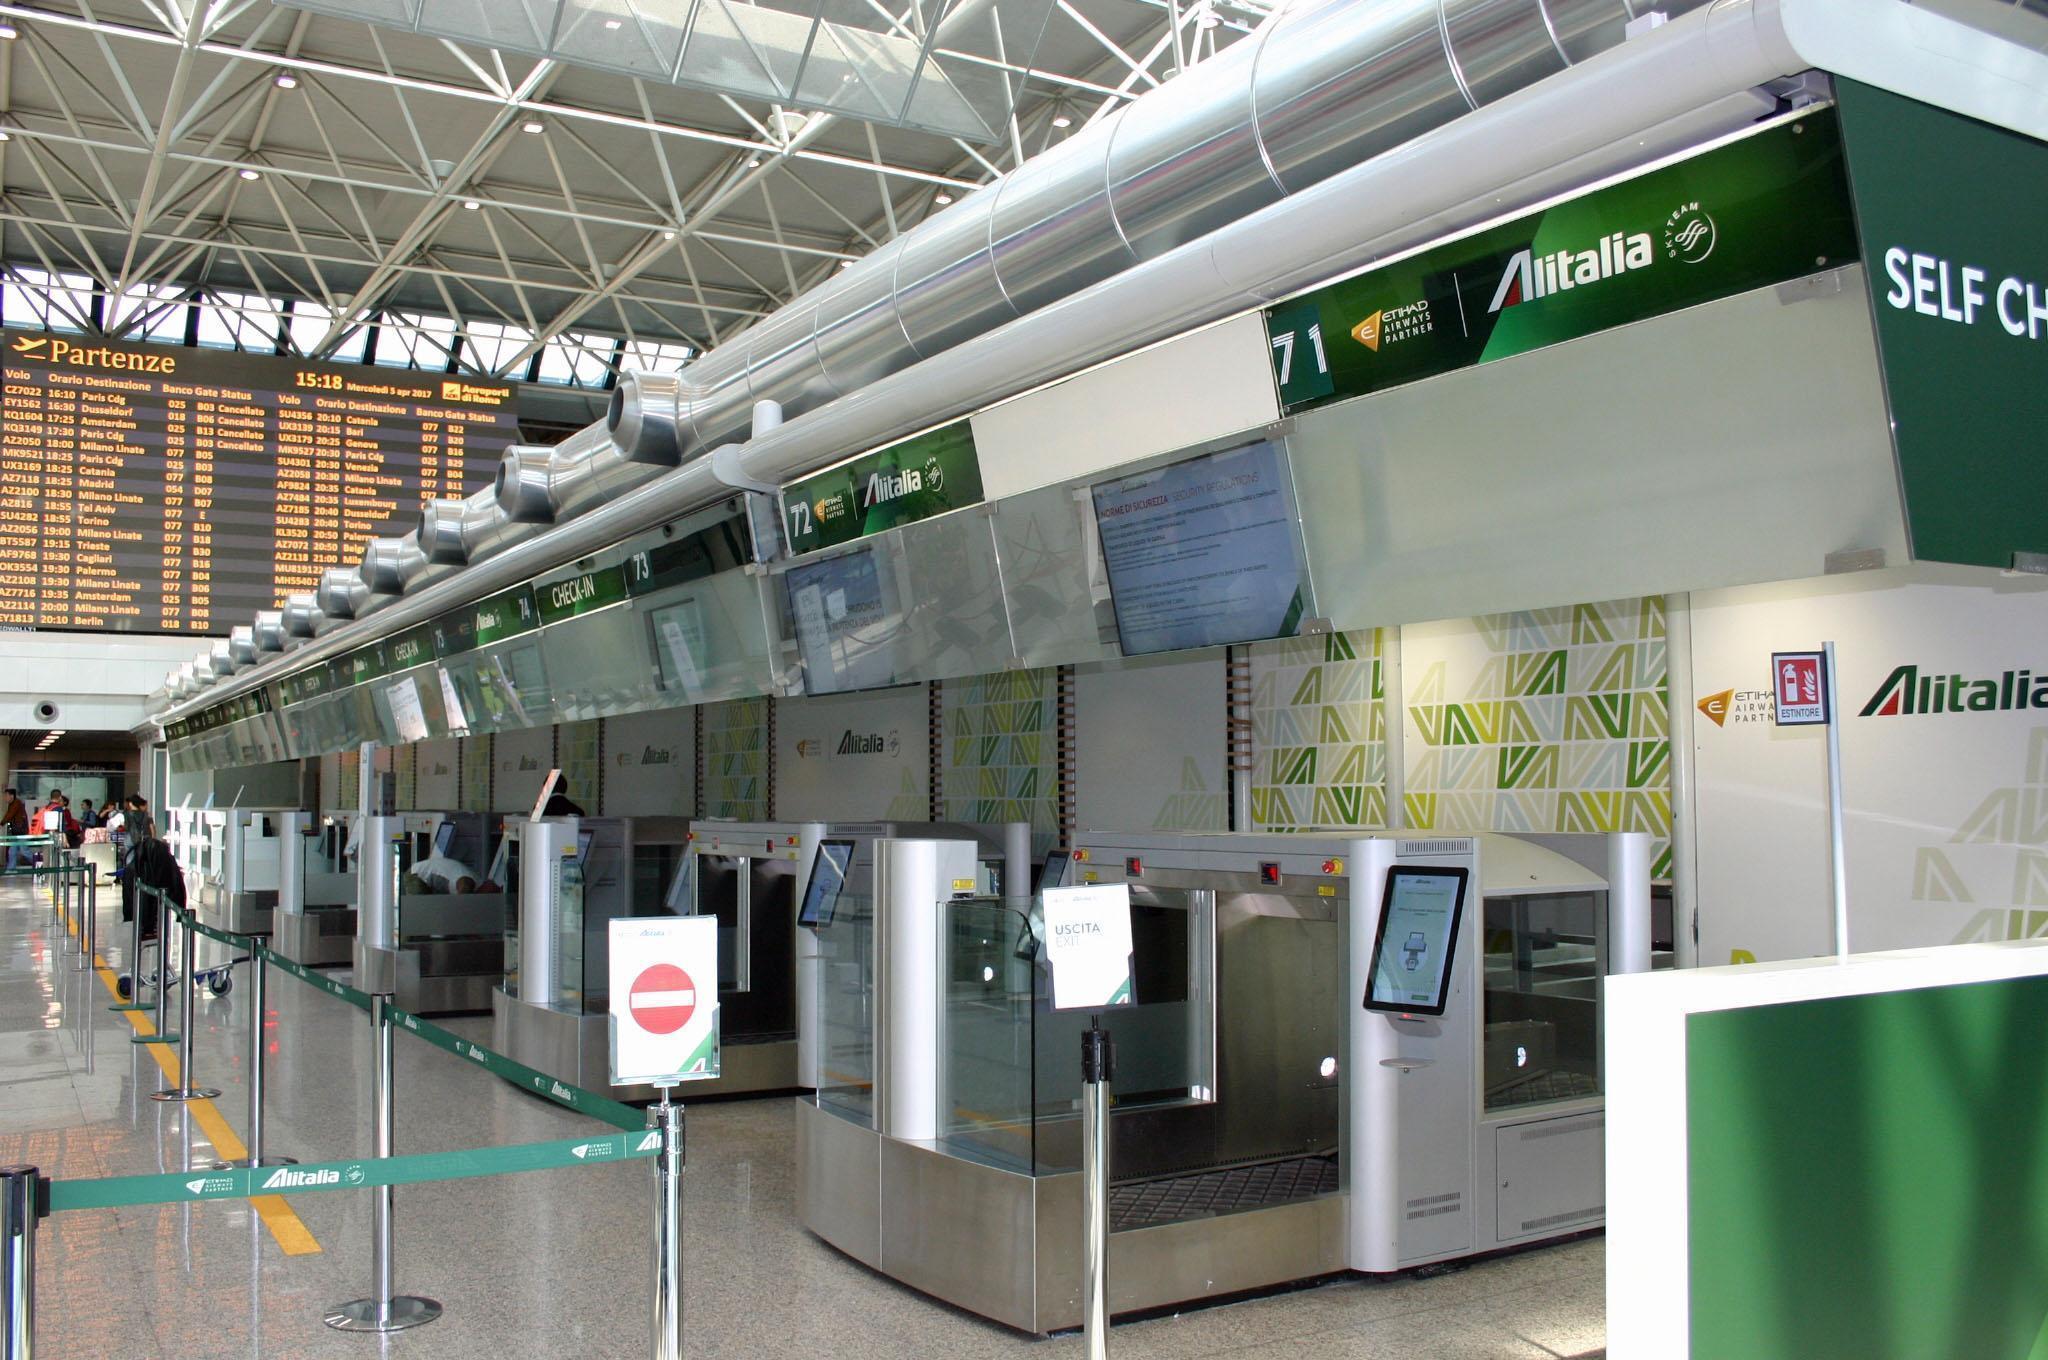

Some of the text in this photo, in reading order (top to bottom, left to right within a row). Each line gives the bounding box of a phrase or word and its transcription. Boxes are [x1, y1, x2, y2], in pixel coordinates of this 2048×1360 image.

[1487, 231, 1652, 313] Alitalia
[1884, 247, 2048, 340] SELF CH
[1381, 299, 1429, 322] ETIHAD
[1384, 311, 1432, 334] AIRWAYS
[1385, 321, 1433, 345] PARTNER
[50, 340, 176, 374] Partenze
[1272, 323, 1328, 387] 71
[5, 369, 252, 401] Volo Orario Destinazione Banco Gate Status
[296, 371, 343, 390] 15:18
[397, 389, 410, 398] apr
[412, 389, 432, 398] 2017
[462, 384, 509, 398] Aeroporti
[5, 385, 265, 416] CZ7022 16:10 Paris Cdg 025 B03 Cancellato
[278, 394, 496, 423] Volo Orario Destinazione Banco Gate Status
[462, 394, 501, 405] di Roma
[4, 398, 265, 428] EY1562 16:30 Dusseldorf 018 B06 Cancellato
[317, 413, 341, 423] 20:10
[346, 416, 378, 426] Catania
[422, 423, 438, 431] 077
[47, 415, 75, 424] 17:25
[81, 417, 136, 430] Amsterdam
[167, 424, 185, 433] 025
[196, 426, 214, 436] B13
[218, 429, 264, 440] Cancellato
[4, 436, 213, 460] AZ2050 18:00 Milano Linate 077 B05
[47, 427, 74, 437] 17:30
[80, 429, 104, 440] Paris
[106, 431, 125, 443] Cdg
[167, 436, 185, 445] 025
[196, 438, 214, 448] B03
[217, 441, 264, 452] Cancellato
[3, 448, 213, 472] MK9521 18:25 Paris Cdg 025 B03
[3, 461, 213, 484] UX3169 18:25 Catania 077 B08
[315, 472, 339, 481] 20:30
[345, 474, 374, 484] Milano
[376, 477, 402, 486] Linate
[421, 480, 437, 488] 077
[447, 482, 463, 490] B11
[3, 474, 212, 496] AZ7118 18:25 Madrid 054 D07
[863, 469, 922, 508] Alitalia
[2, 486, 212, 509] AZ2100 18:30 Milano Linate 077 B07
[1133, 495, 1169, 513] SICUREZZA
[2, 499, 206, 520] AZ816 18:55 Tel Aviv 077 E
[789, 501, 813, 538] 72
[2, 512, 211, 533] SU4282 18:55 Torino 077 B10
[0, 525, 211, 545] AZ2056 19:00 Milano Linate 077 B18
[633, 551, 649, 581] 73
[552, 574, 595, 608] CHECK-IN
[518, 597, 530, 620] 74
[1735, 690, 1776, 702] ETIHA
[1858, 664, 2048, 717] Alitalia
[1735, 701, 1775, 712] AIRWA
[1735, 713, 1774, 723] PARTN
[1781, 707, 1820, 718] ESTINTORE
[837, 729, 884, 755] Alitalia
[1055, 923, 1101, 935] USCITA
[1055, 935, 1080, 948] EXIT
[262, 1168, 340, 1189] Alitalia
